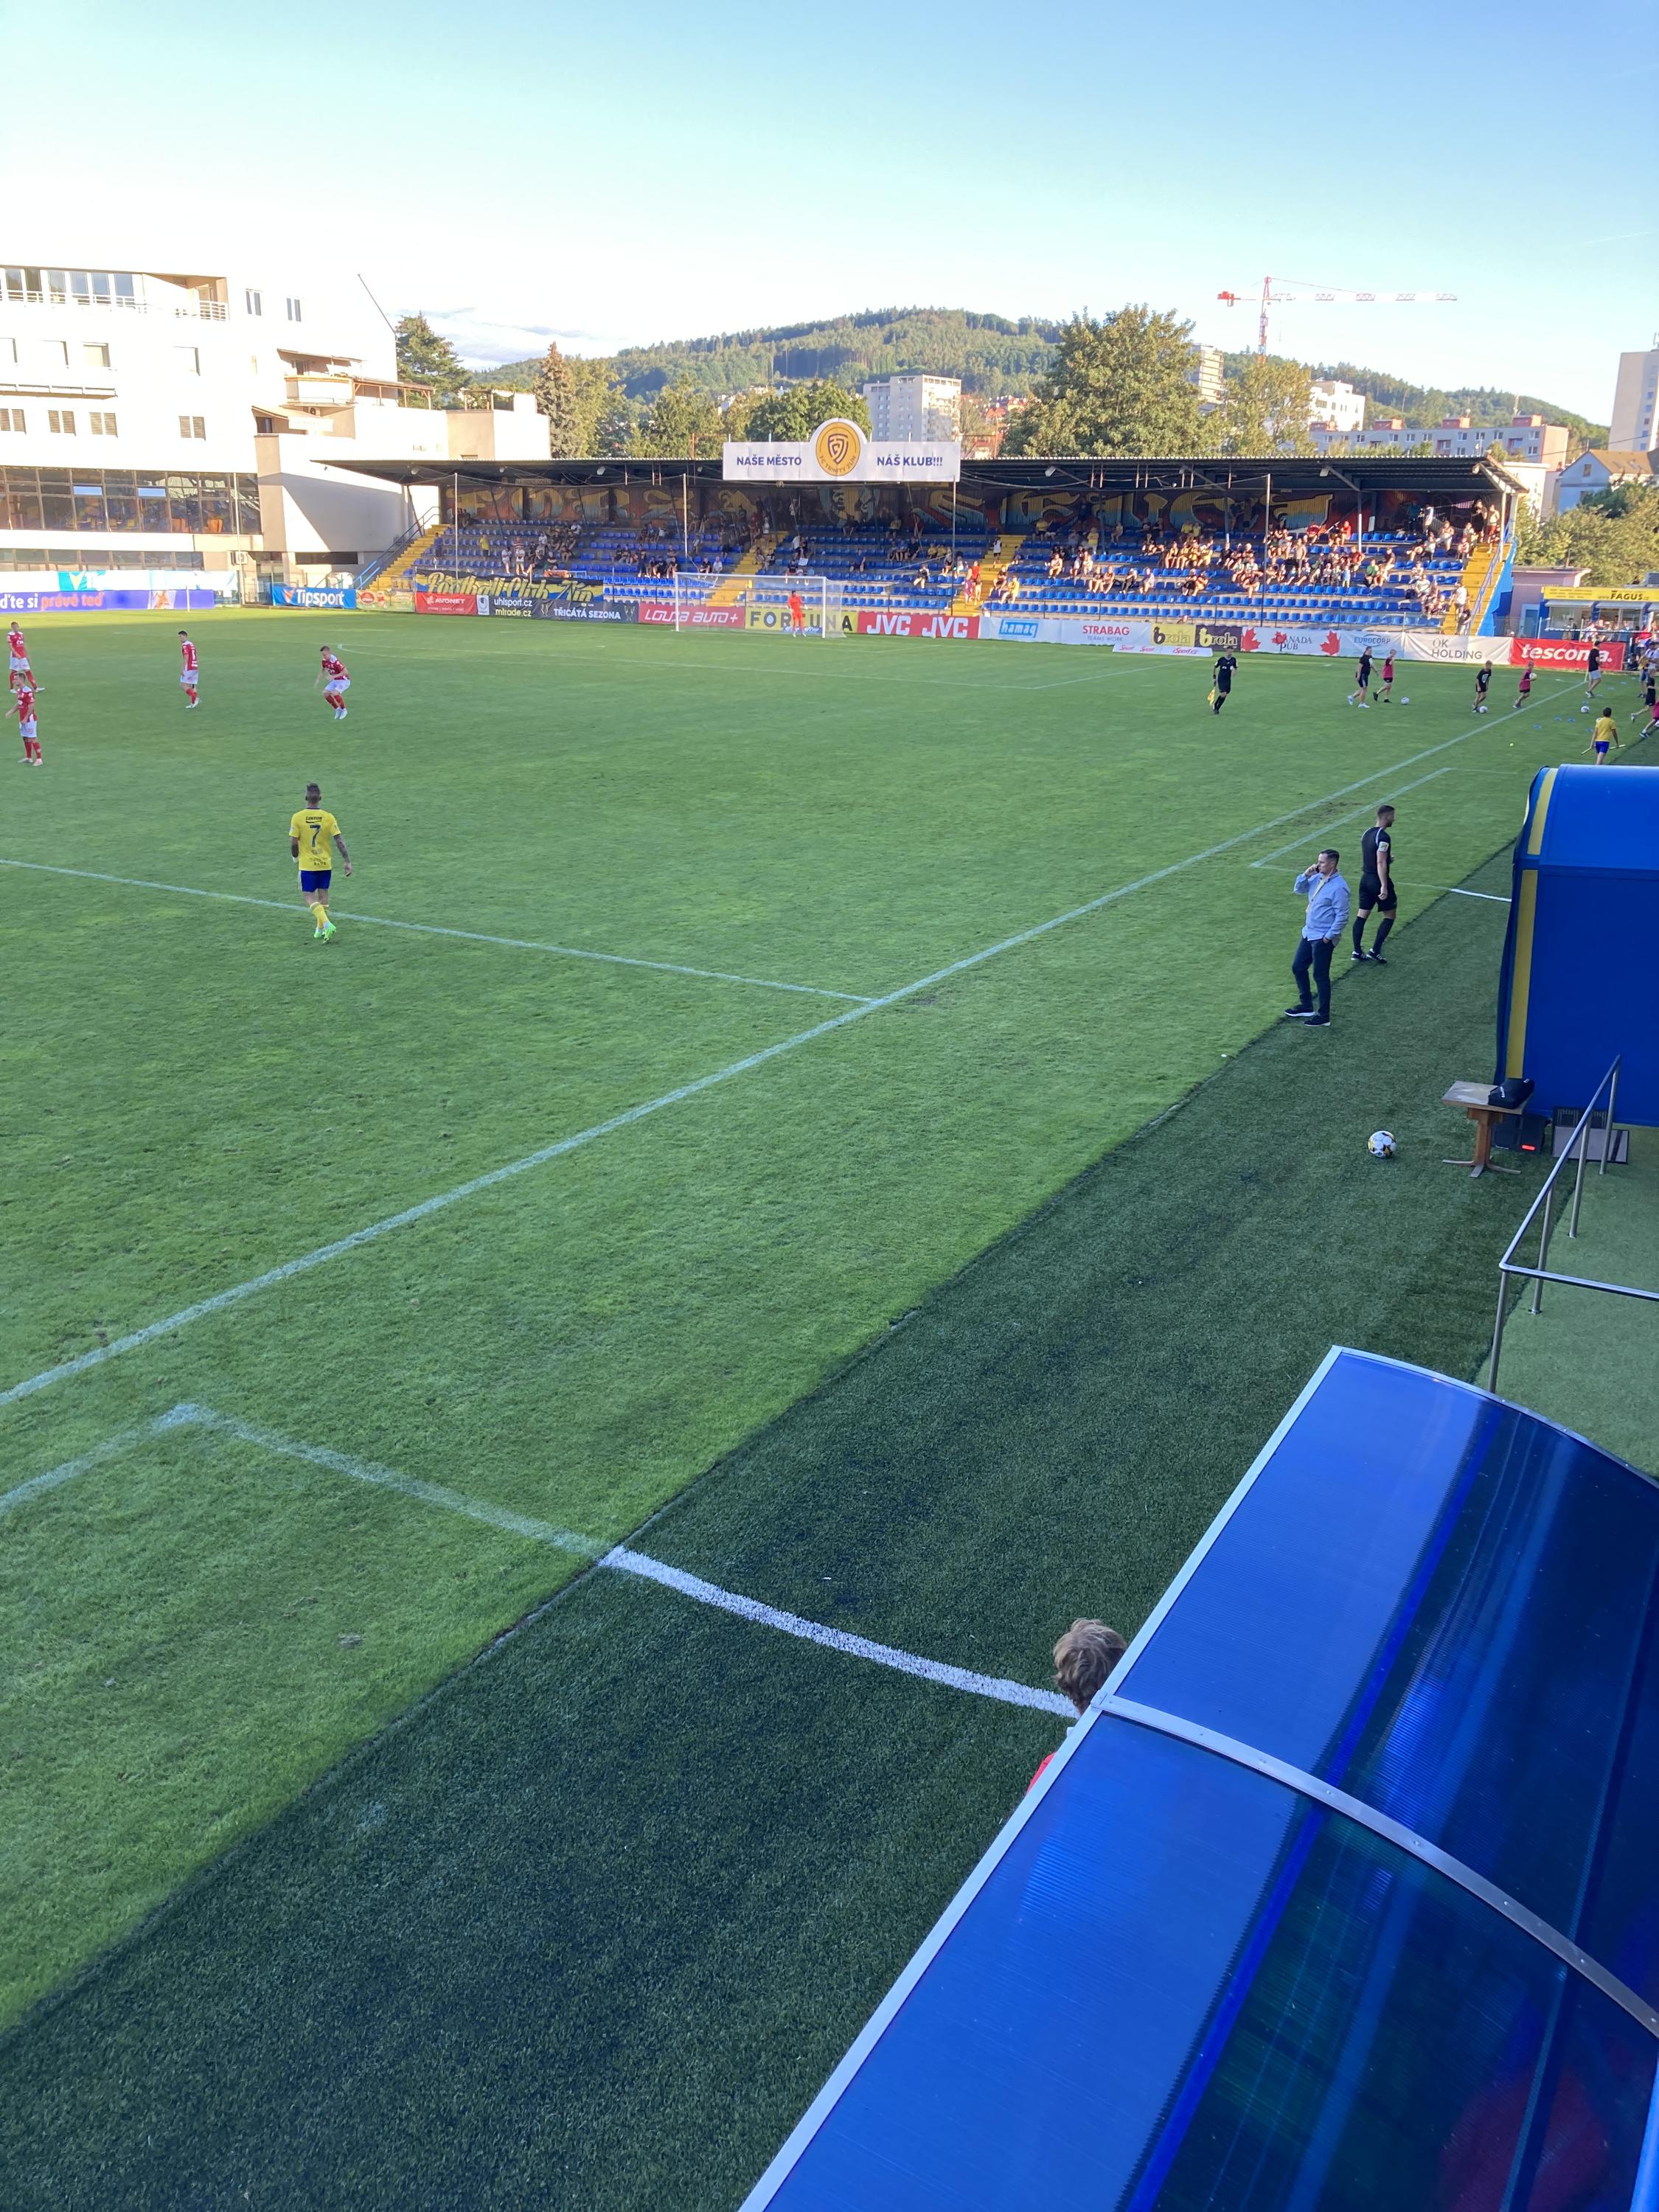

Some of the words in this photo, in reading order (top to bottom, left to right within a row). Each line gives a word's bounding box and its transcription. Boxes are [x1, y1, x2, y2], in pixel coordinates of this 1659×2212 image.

[737, 453, 765, 465] NAŠE
[766, 453, 802, 466] MĚSTO
[877, 453, 900, 466] NÁŠ
[903, 456, 943, 467] KLUB!!!
[27, 593, 38, 608] si
[296, 589, 344, 607] Tipsport
[494, 597, 533, 608] uhlsport.cz
[554, 606, 587, 619] TŘICÁTÁ
[588, 610, 622, 620] SEZONA
[750, 611, 853, 632] FORUNA
[866, 613, 911, 636] JVC
[922, 616, 969, 639] JVC
[1082, 625, 1130, 636] STRABAG
[1199, 627, 1238, 647] brola
[1280, 641, 1298, 652] PUB
[1354, 636, 1391, 644] EUROCORP
[1433, 638, 1448, 648] OK
[1431, 649, 1483, 660] HOLDING
[310, 824, 321, 848] 7
